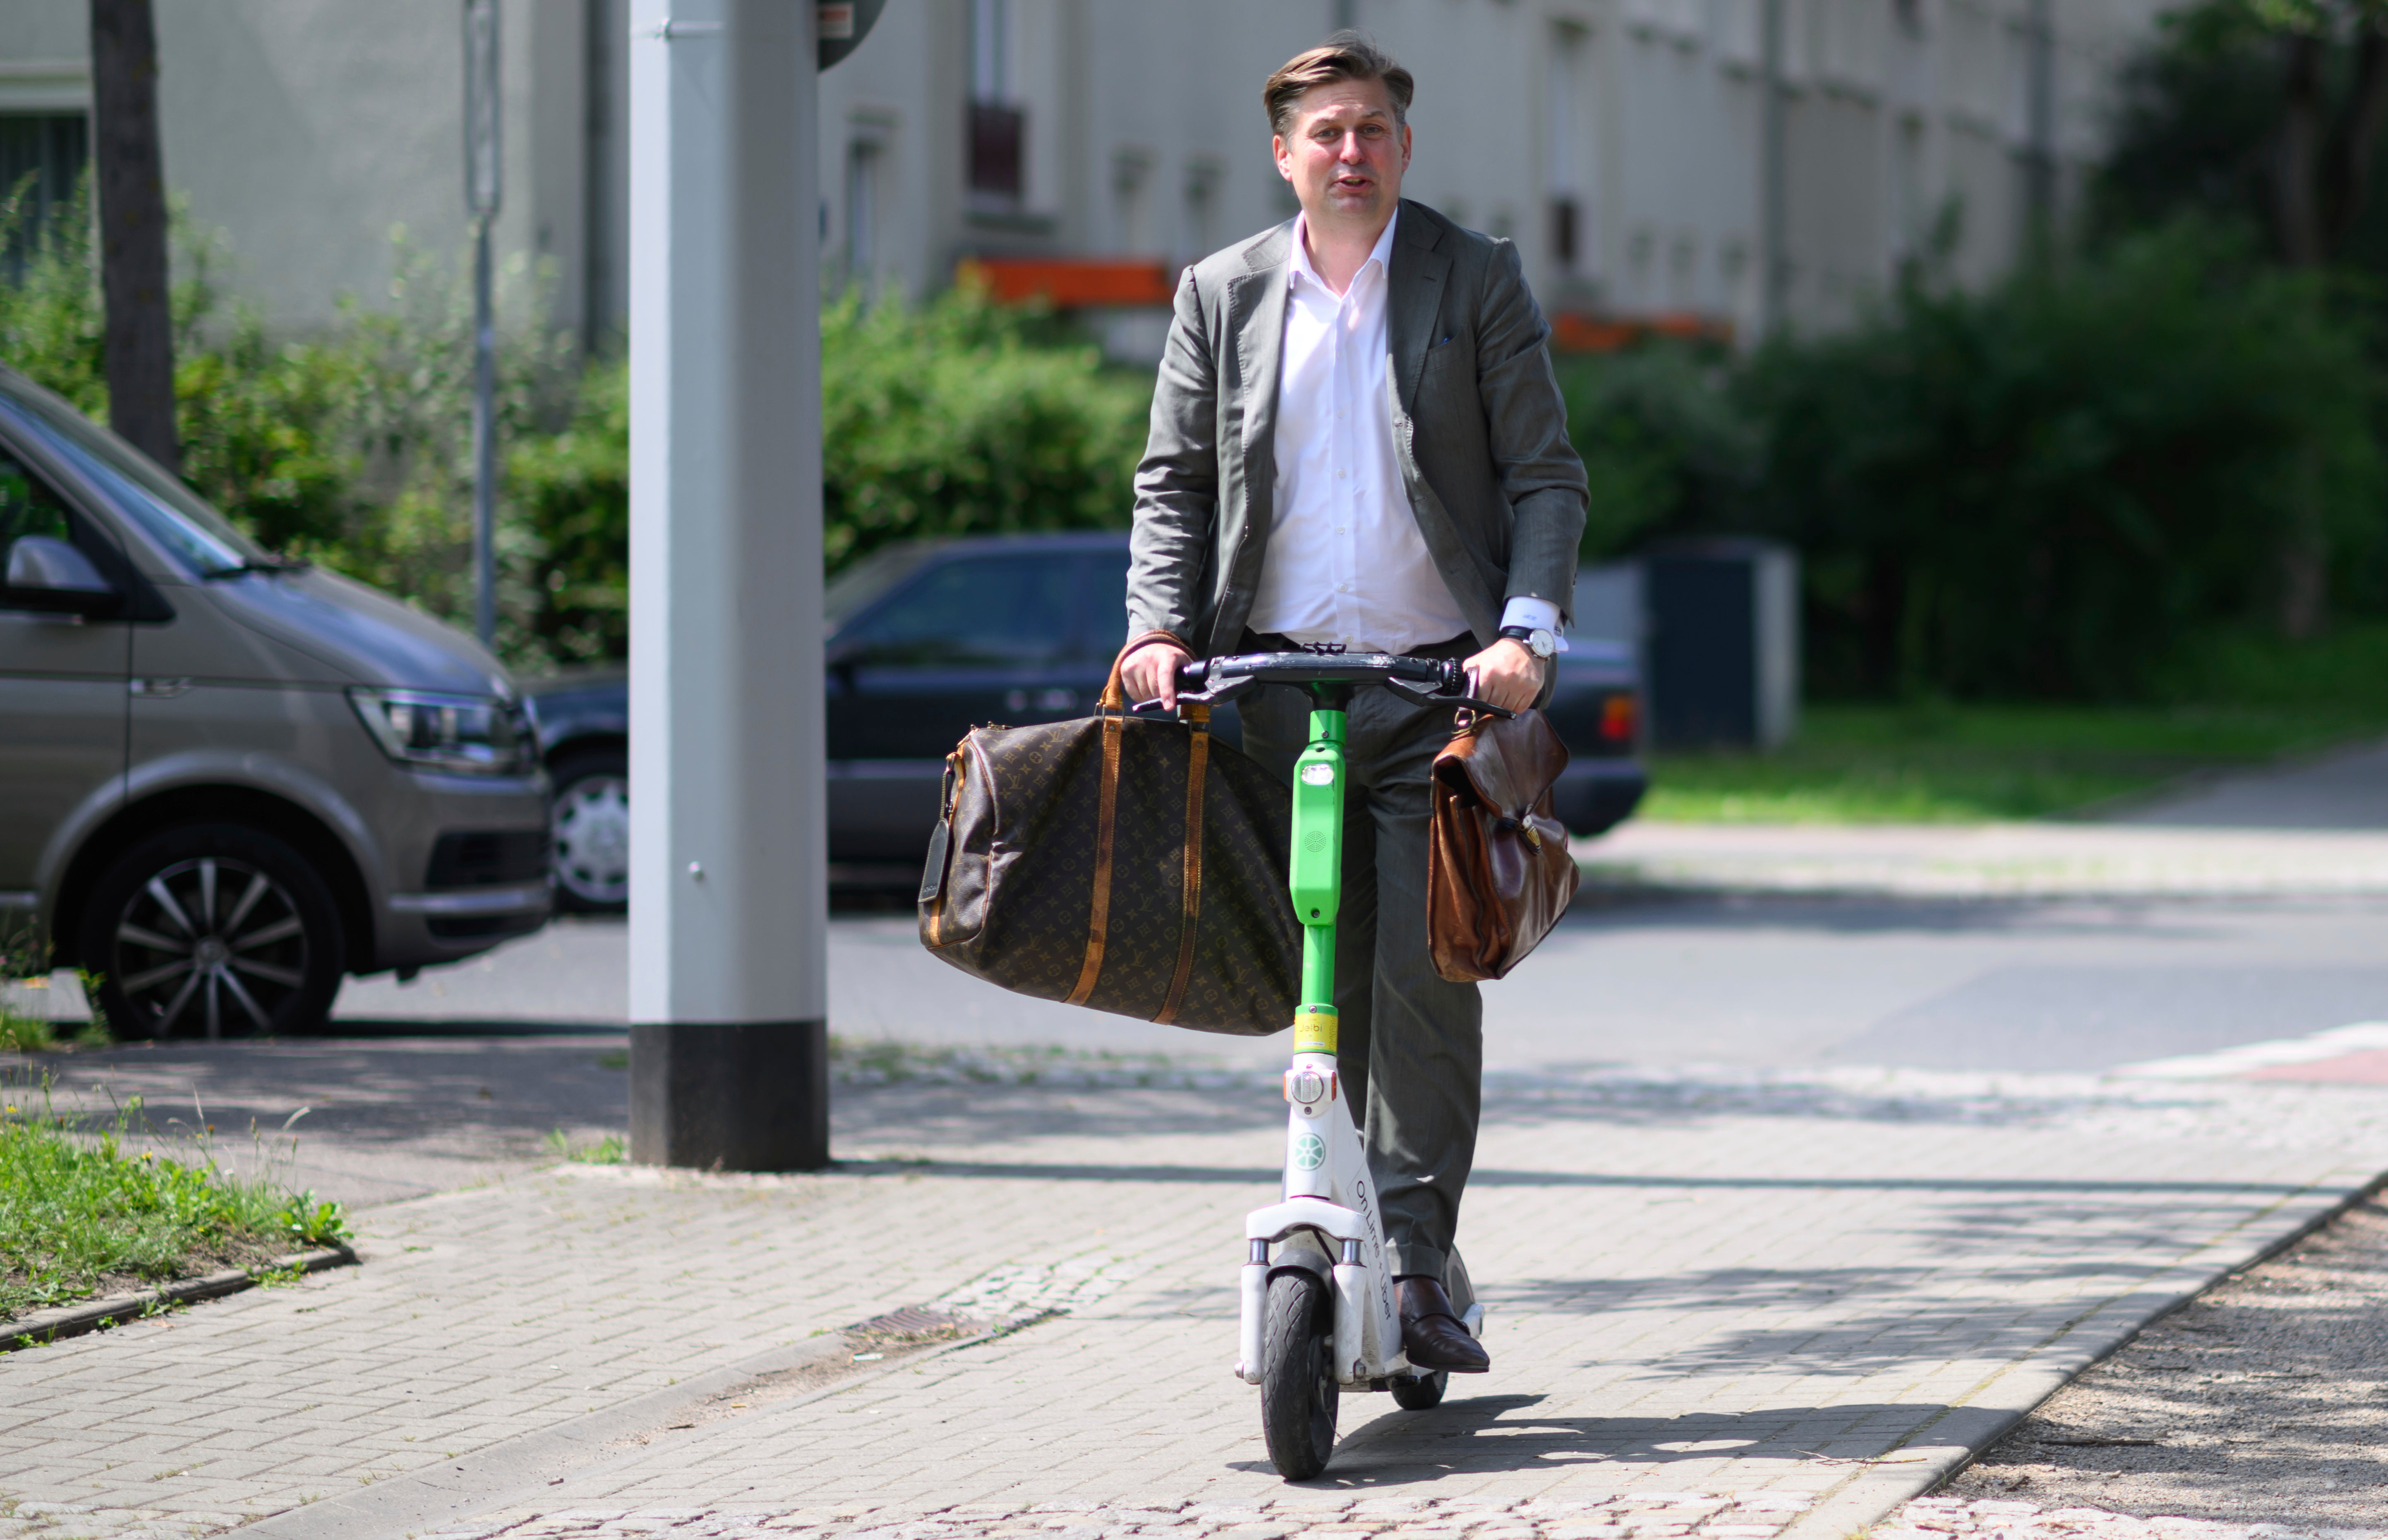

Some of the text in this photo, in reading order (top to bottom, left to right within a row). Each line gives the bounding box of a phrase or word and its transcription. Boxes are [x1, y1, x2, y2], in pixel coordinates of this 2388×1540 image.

[1299, 1024, 1322, 1032] Jelbi
[1357, 1180, 1368, 1212] On
[1366, 1210, 1380, 1259] Lime
[1380, 1272, 1391, 1320] Uber
